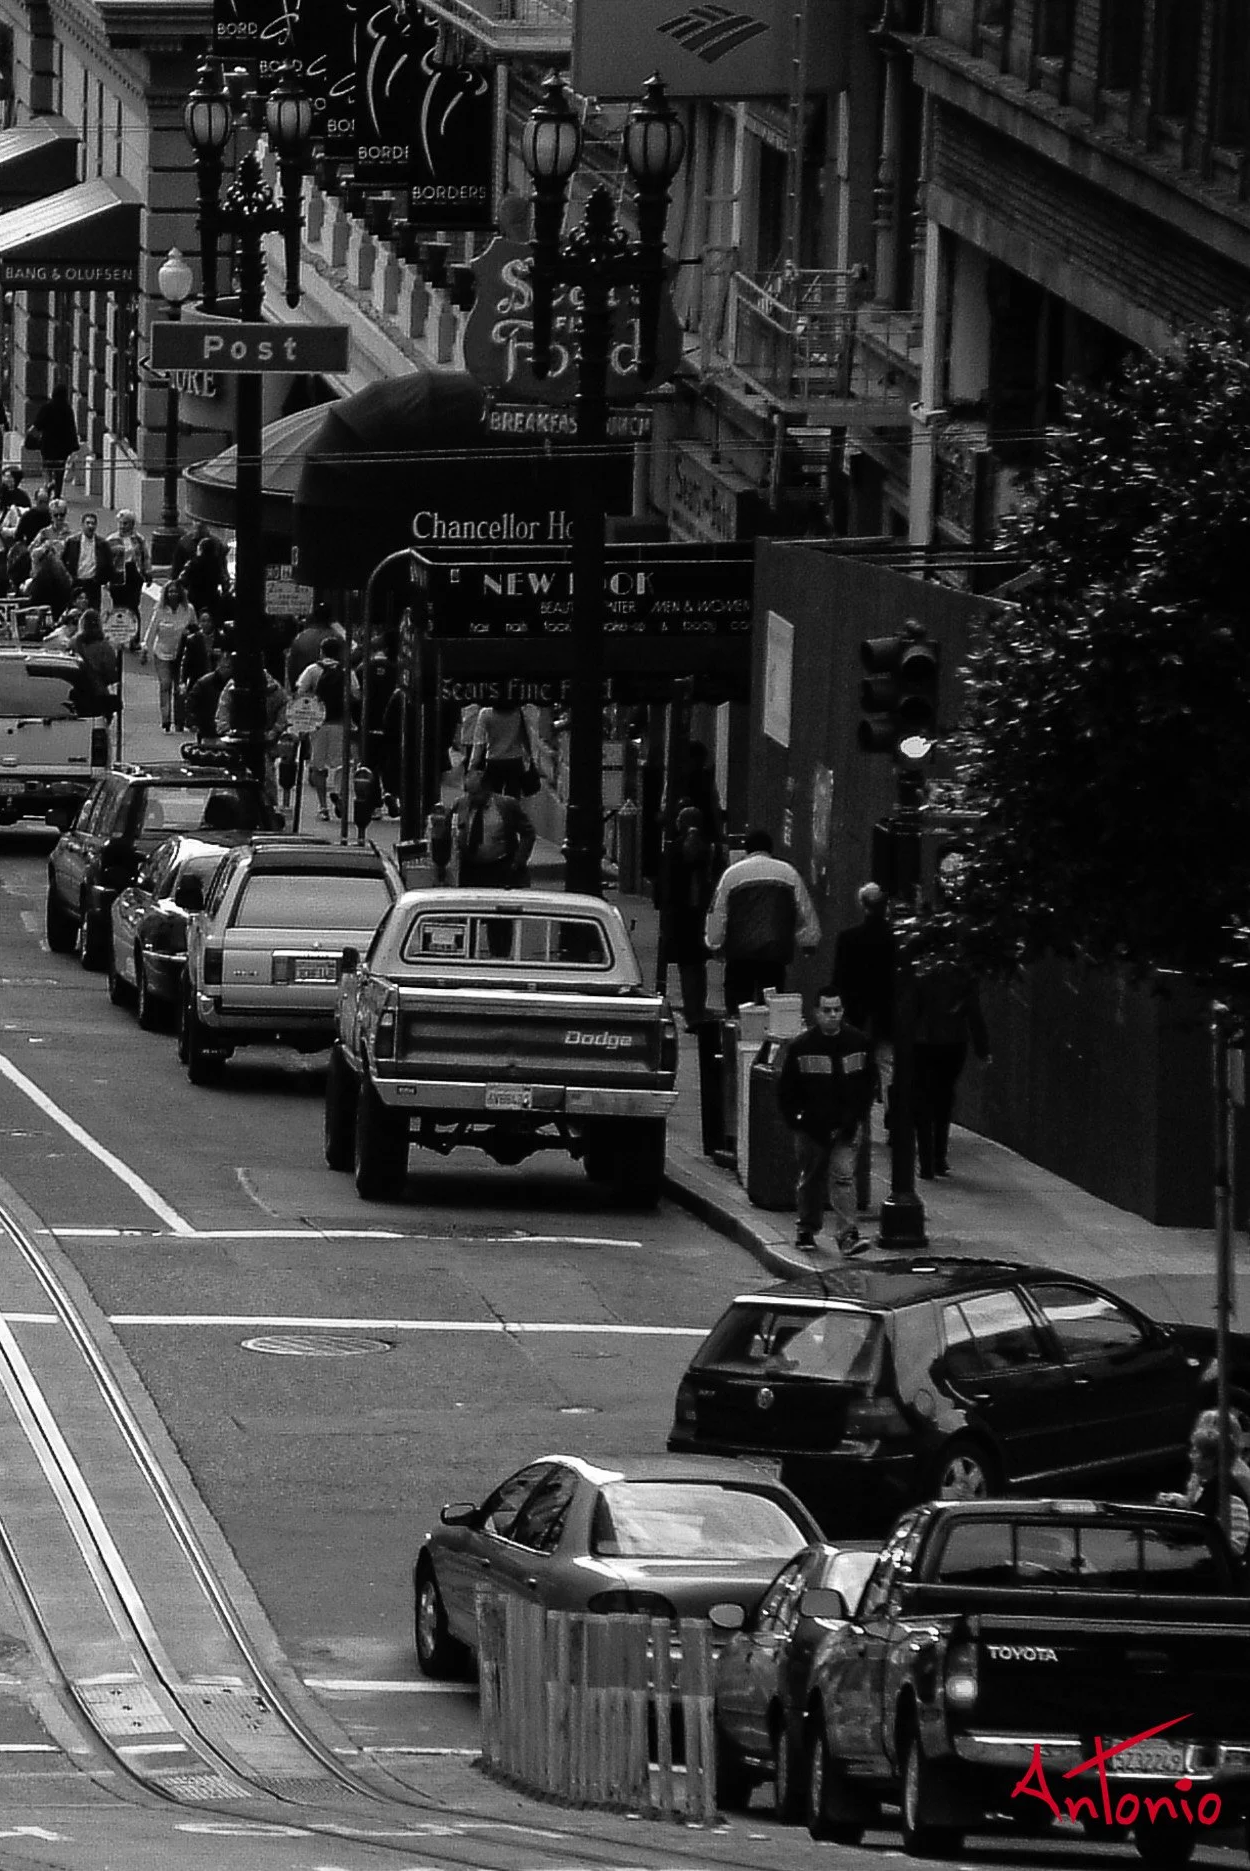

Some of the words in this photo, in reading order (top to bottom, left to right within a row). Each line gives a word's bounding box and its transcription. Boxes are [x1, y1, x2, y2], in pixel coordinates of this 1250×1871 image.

[217, 22, 258, 35] BORD
[412, 185, 486, 200] BORDERS
[5, 266, 47, 281] BANG
[52, 267, 61, 281] &
[65, 267, 133, 281] OLUFSEN
[203, 335, 298, 361] Post
[489, 411, 579, 435] BREAKFAS
[412, 510, 540, 540] Chancellor
[547, 510, 574, 540] Ho
[483, 572, 556, 596] NEW
[540, 601, 574, 615] BEAUT
[604, 600, 637, 614] NTER
[564, 1030, 633, 1050] Dodge
[986, 1644, 1059, 1662] TOYOTA
